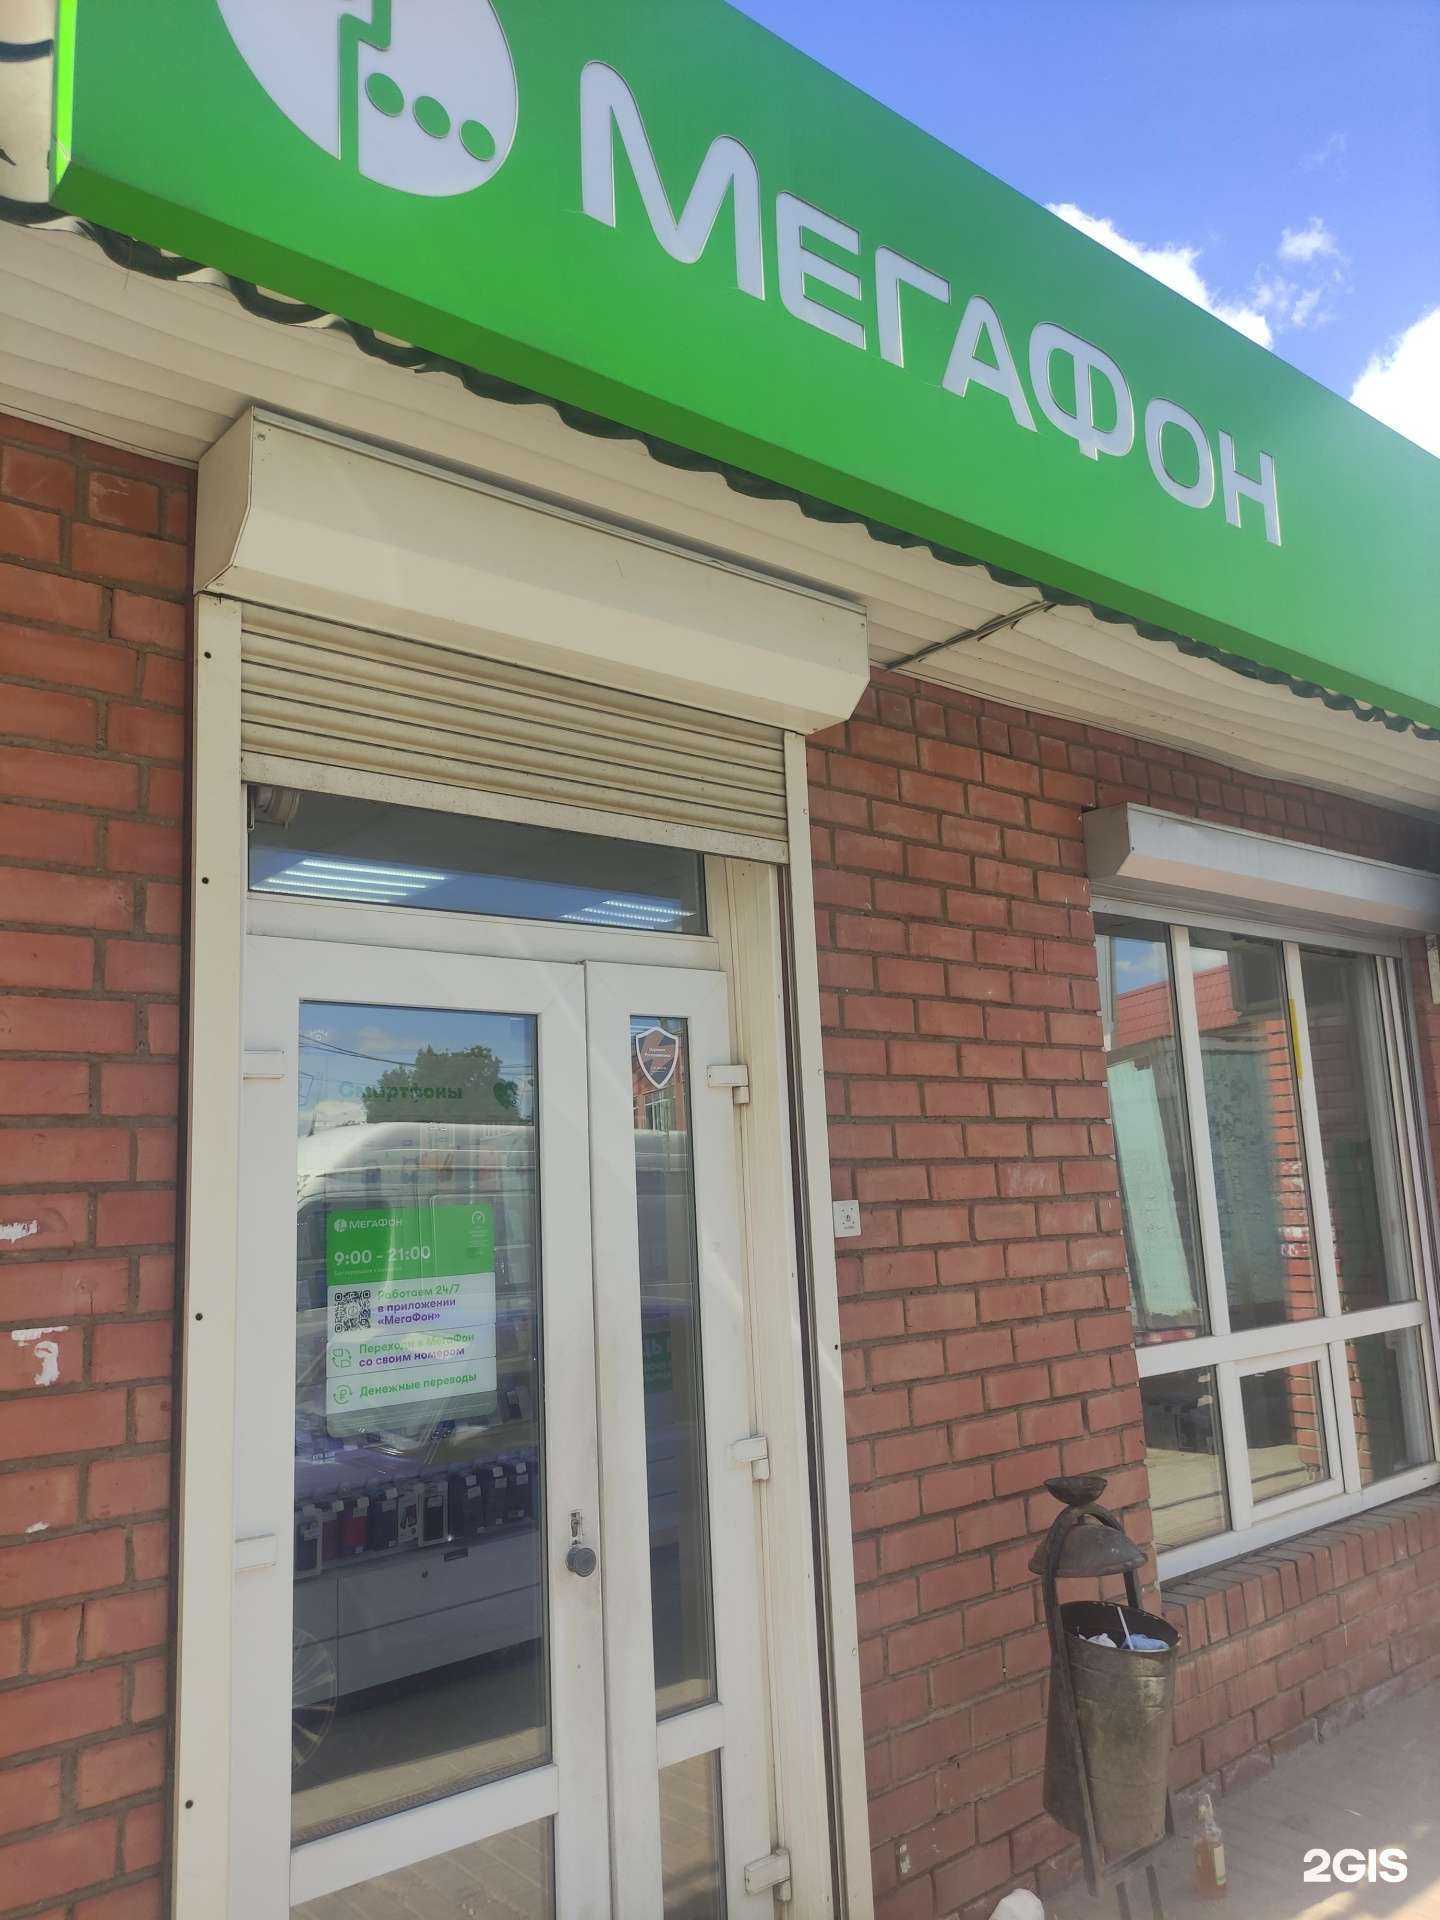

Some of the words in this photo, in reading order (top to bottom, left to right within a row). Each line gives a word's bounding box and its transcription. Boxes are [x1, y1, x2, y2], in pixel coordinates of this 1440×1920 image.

[334, 1249, 372, 1266] 9:00
[388, 1245, 431, 1263] 21:00
[378, 1288, 433, 1300] Работаем
[435, 1283, 461, 1295] 24/7
[387, 1299, 456, 1314] приложении
[378, 1312, 441, 1325] «МегаФон»
[359, 1358, 373, 1368] со
[376, 1354, 411, 1365] своим
[414, 1347, 465, 1360] номером
[360, 1382, 421, 1398] Денежные
[423, 1374, 477, 1388] переводы
